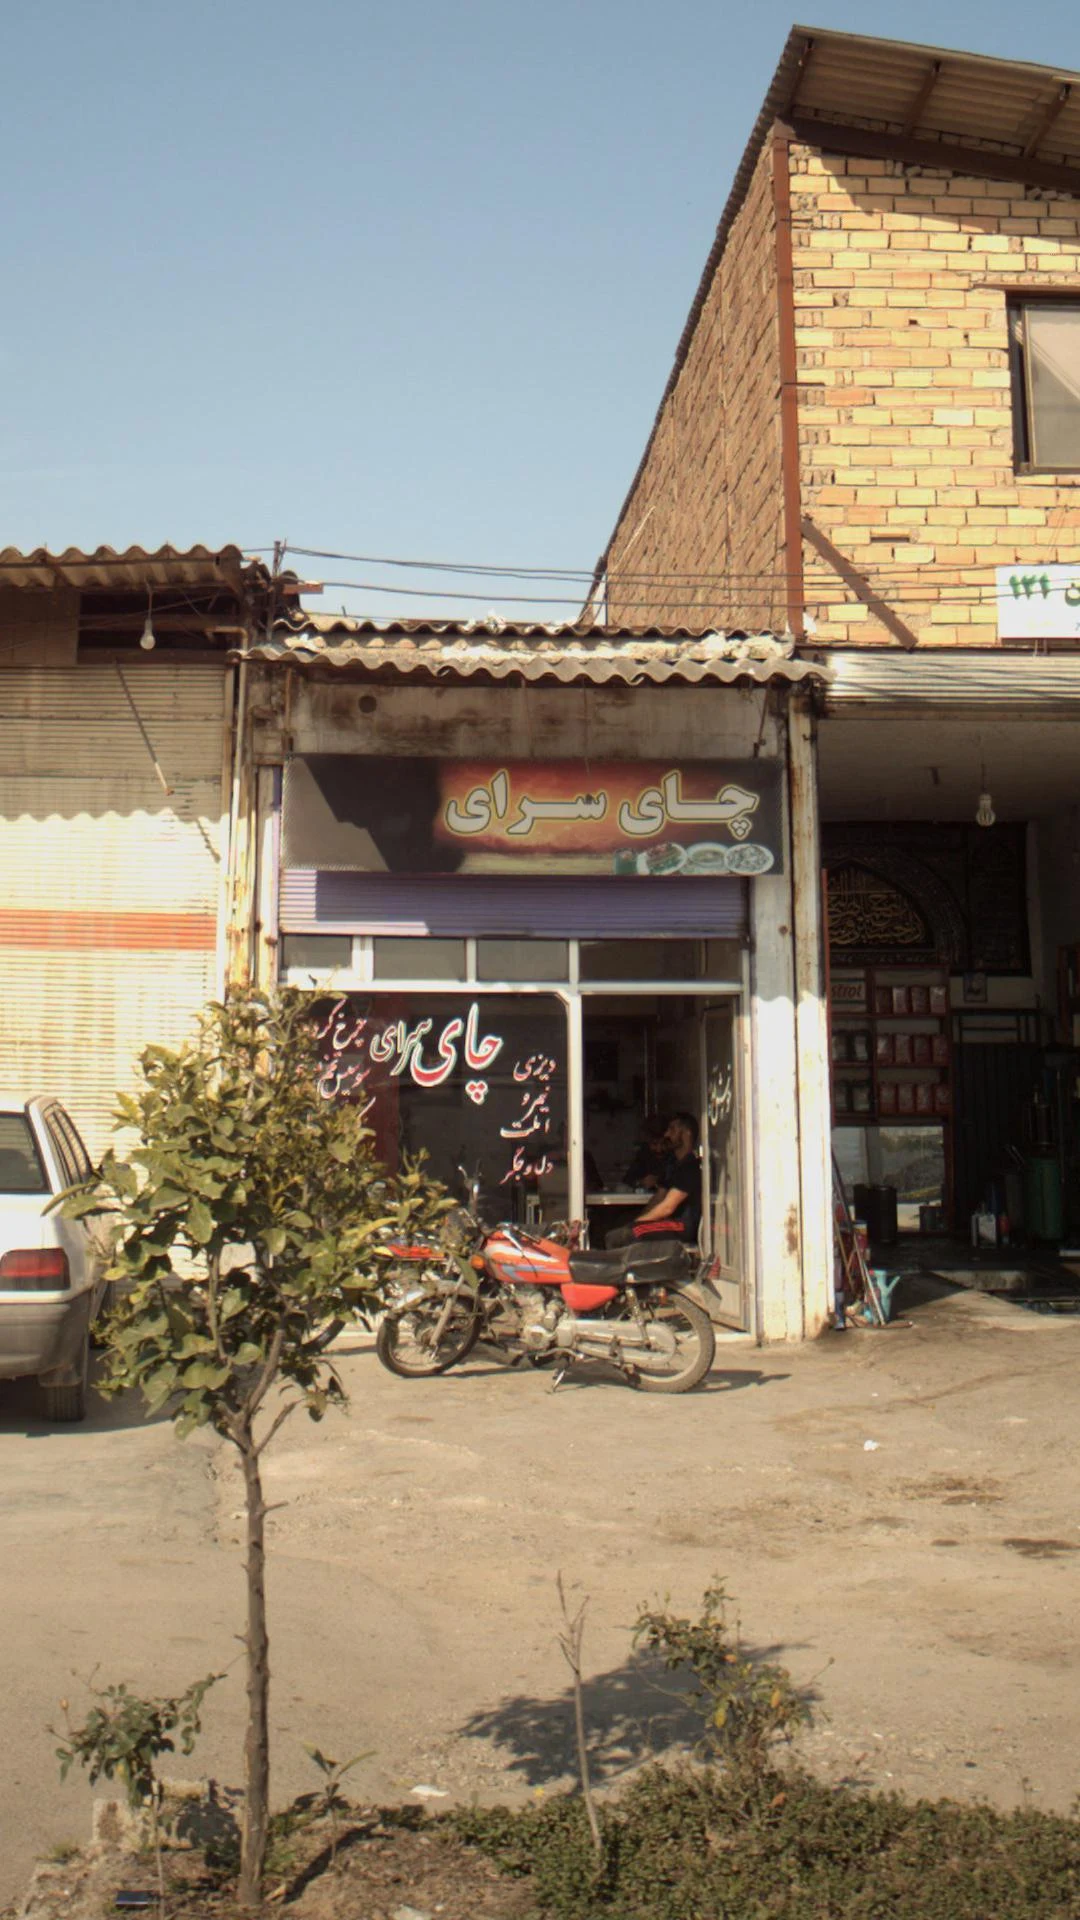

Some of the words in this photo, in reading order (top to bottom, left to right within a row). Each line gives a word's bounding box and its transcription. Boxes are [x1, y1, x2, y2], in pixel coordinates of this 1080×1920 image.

[445, 768, 607, 836] سرای
[618, 769, 760, 839] چای
[830, 983, 863, 999] strol
[369, 1017, 433, 1076] سرای
[410, 1002, 504, 1105] چای
[513, 1054, 557, 1082] دیزی
[520, 1085, 551, 1123] نیمرو
[500, 1114, 551, 1139] املت
[500, 1145, 526, 1185] جگر
[522, 1162, 534, 1177] و
[534, 1154, 555, 1177] دل
